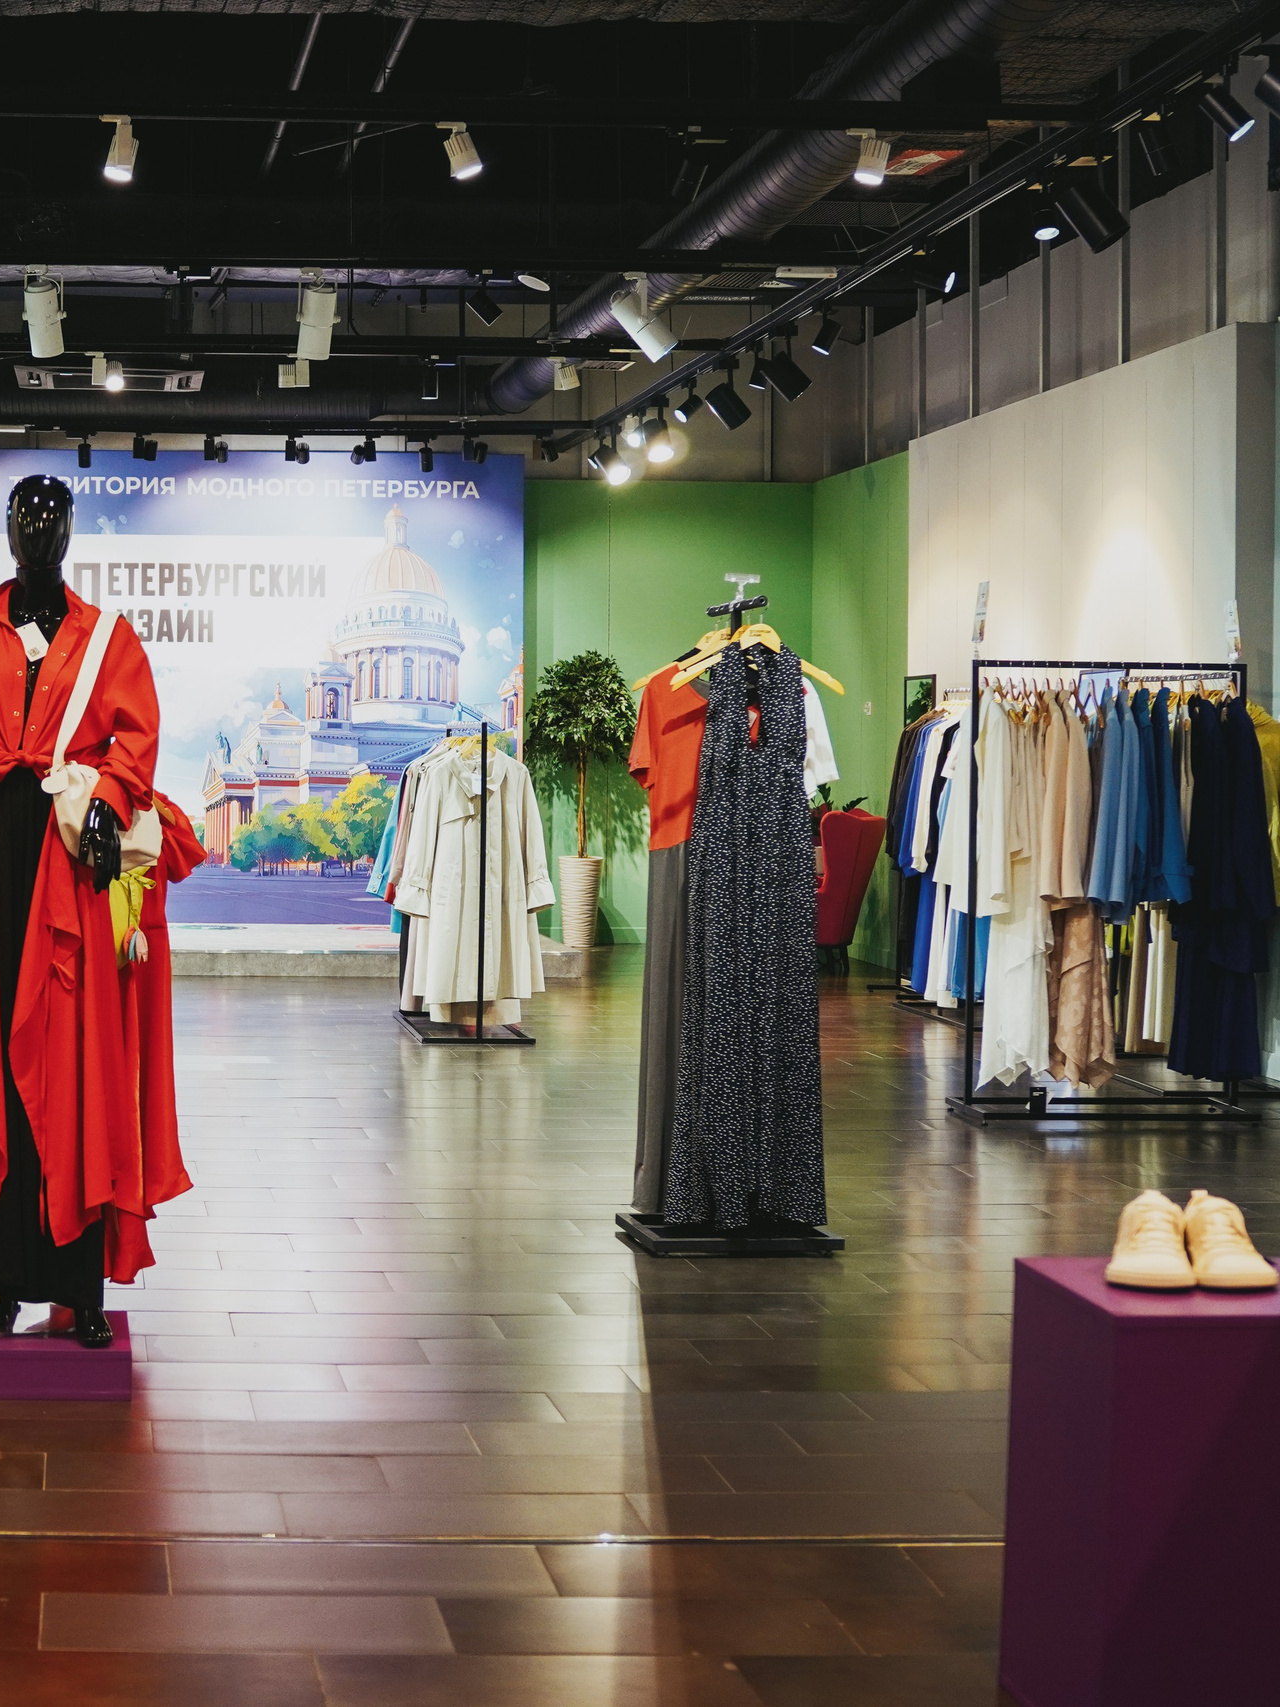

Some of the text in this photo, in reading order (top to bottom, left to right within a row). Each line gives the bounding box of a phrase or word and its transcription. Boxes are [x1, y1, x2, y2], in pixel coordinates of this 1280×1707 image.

[9, 475, 481, 499] ТИТОРИЯ МОДНОГО ПЕТЕРБУРГА
